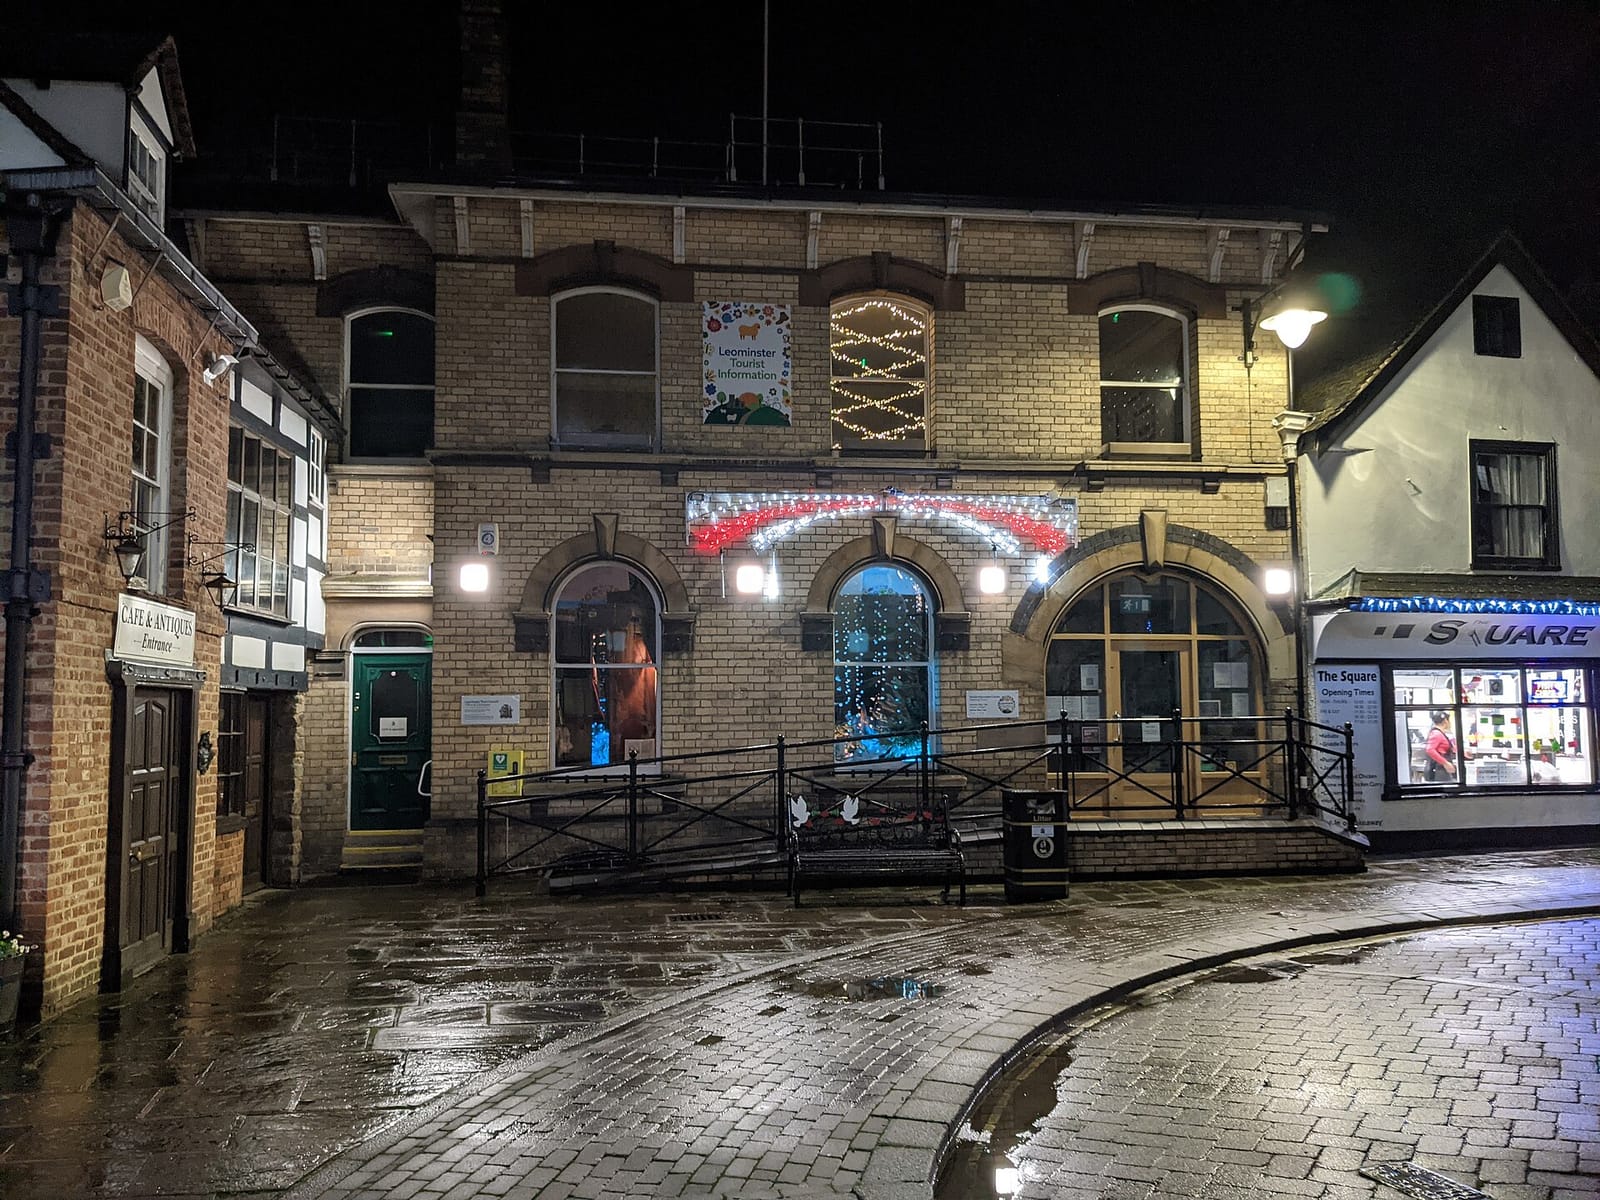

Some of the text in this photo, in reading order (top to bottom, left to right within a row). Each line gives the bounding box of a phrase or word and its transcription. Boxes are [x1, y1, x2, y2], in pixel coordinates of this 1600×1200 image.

[718, 346, 777, 358] Leominster
[730, 358, 766, 369] Tourist
[717, 369, 777, 380] Information
[121, 605, 193, 639] CAFE & ANTIQUES
[142, 633, 173, 653] Entrance
[1317, 670, 1377, 684] The Square
[1321, 688, 1375, 698] Opening Times
